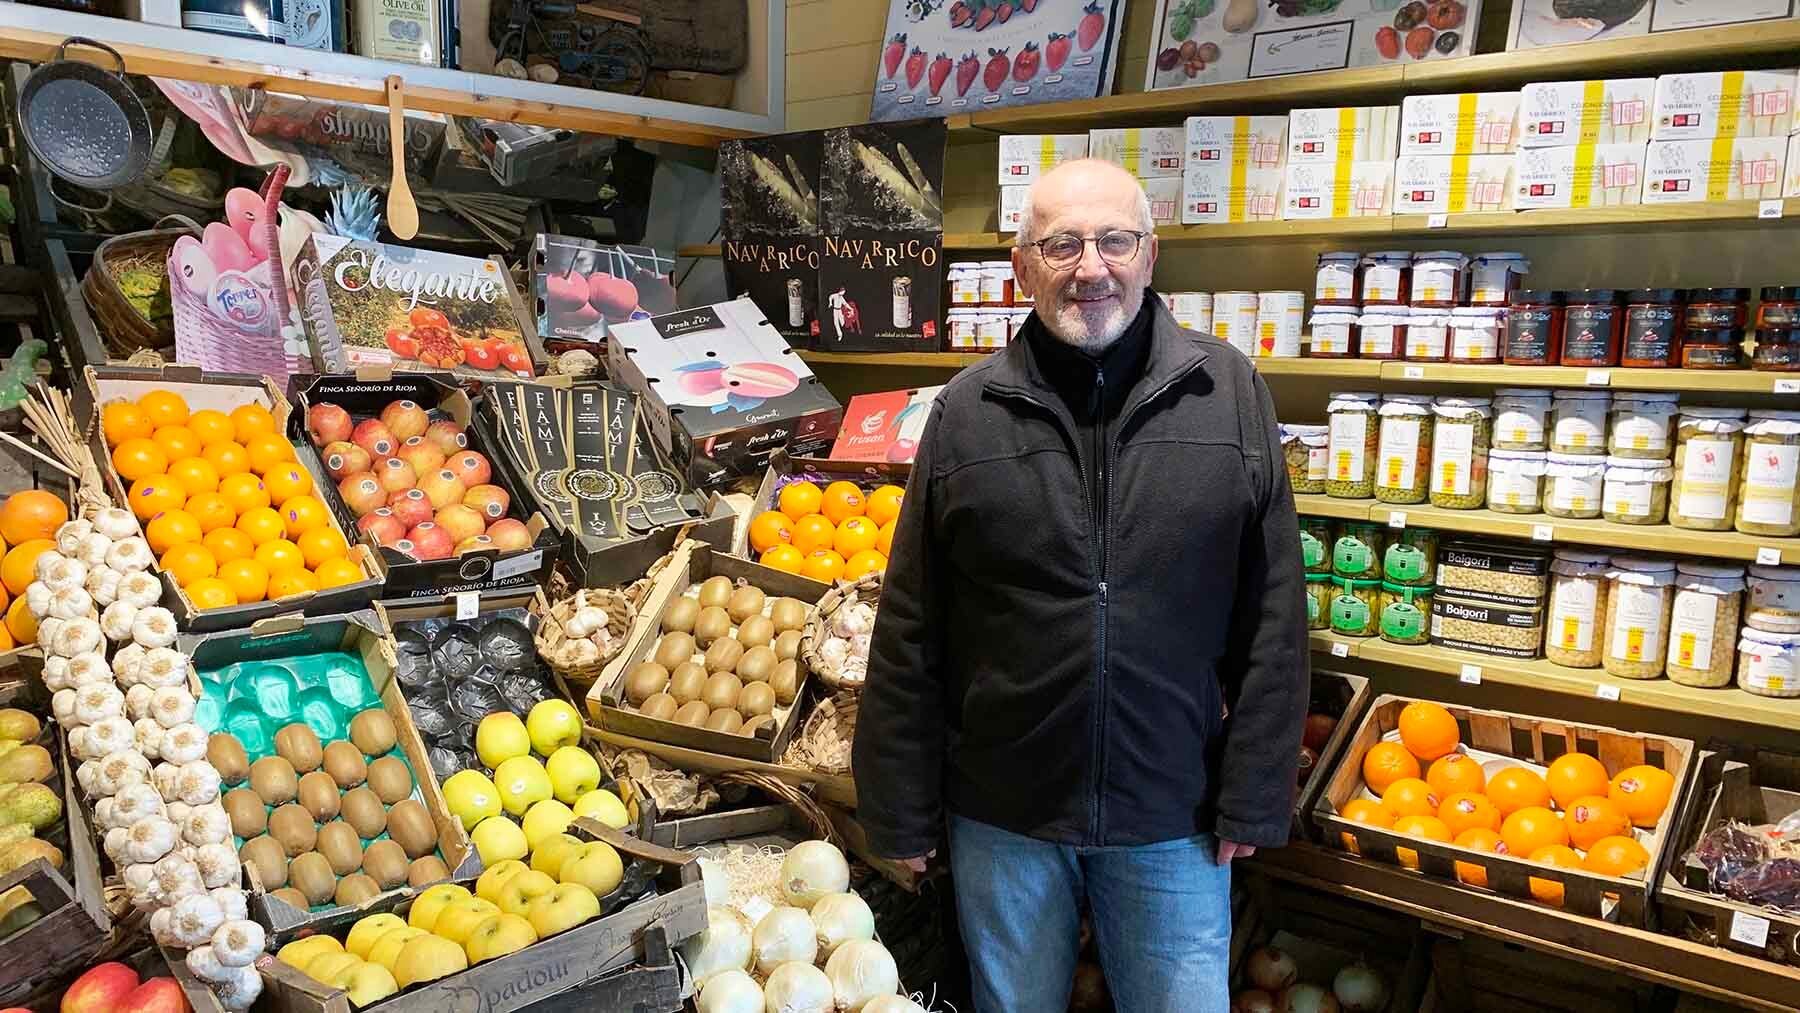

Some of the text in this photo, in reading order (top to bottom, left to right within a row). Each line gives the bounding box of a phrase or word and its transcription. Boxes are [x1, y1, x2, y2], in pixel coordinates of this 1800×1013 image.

[383, 0, 409, 10] OLIVE
[727, 241, 820, 272] NAVARRICO
[824, 235, 937, 268] NAVARRICO
[335, 249, 498, 312] Elegante
[665, 320, 689, 333] fresh
[345, 384, 381, 393] SEÑORÍO
[395, 384, 417, 392] RIOJA
[746, 433, 769, 447] fresh
[1448, 551, 1491, 567] Baigorri
[411, 589, 440, 598] FINCA
[442, 581, 484, 594] SEÑORÍO
[500, 577, 526, 586] RIOJA
[1446, 604, 1489, 619] Baigorri
